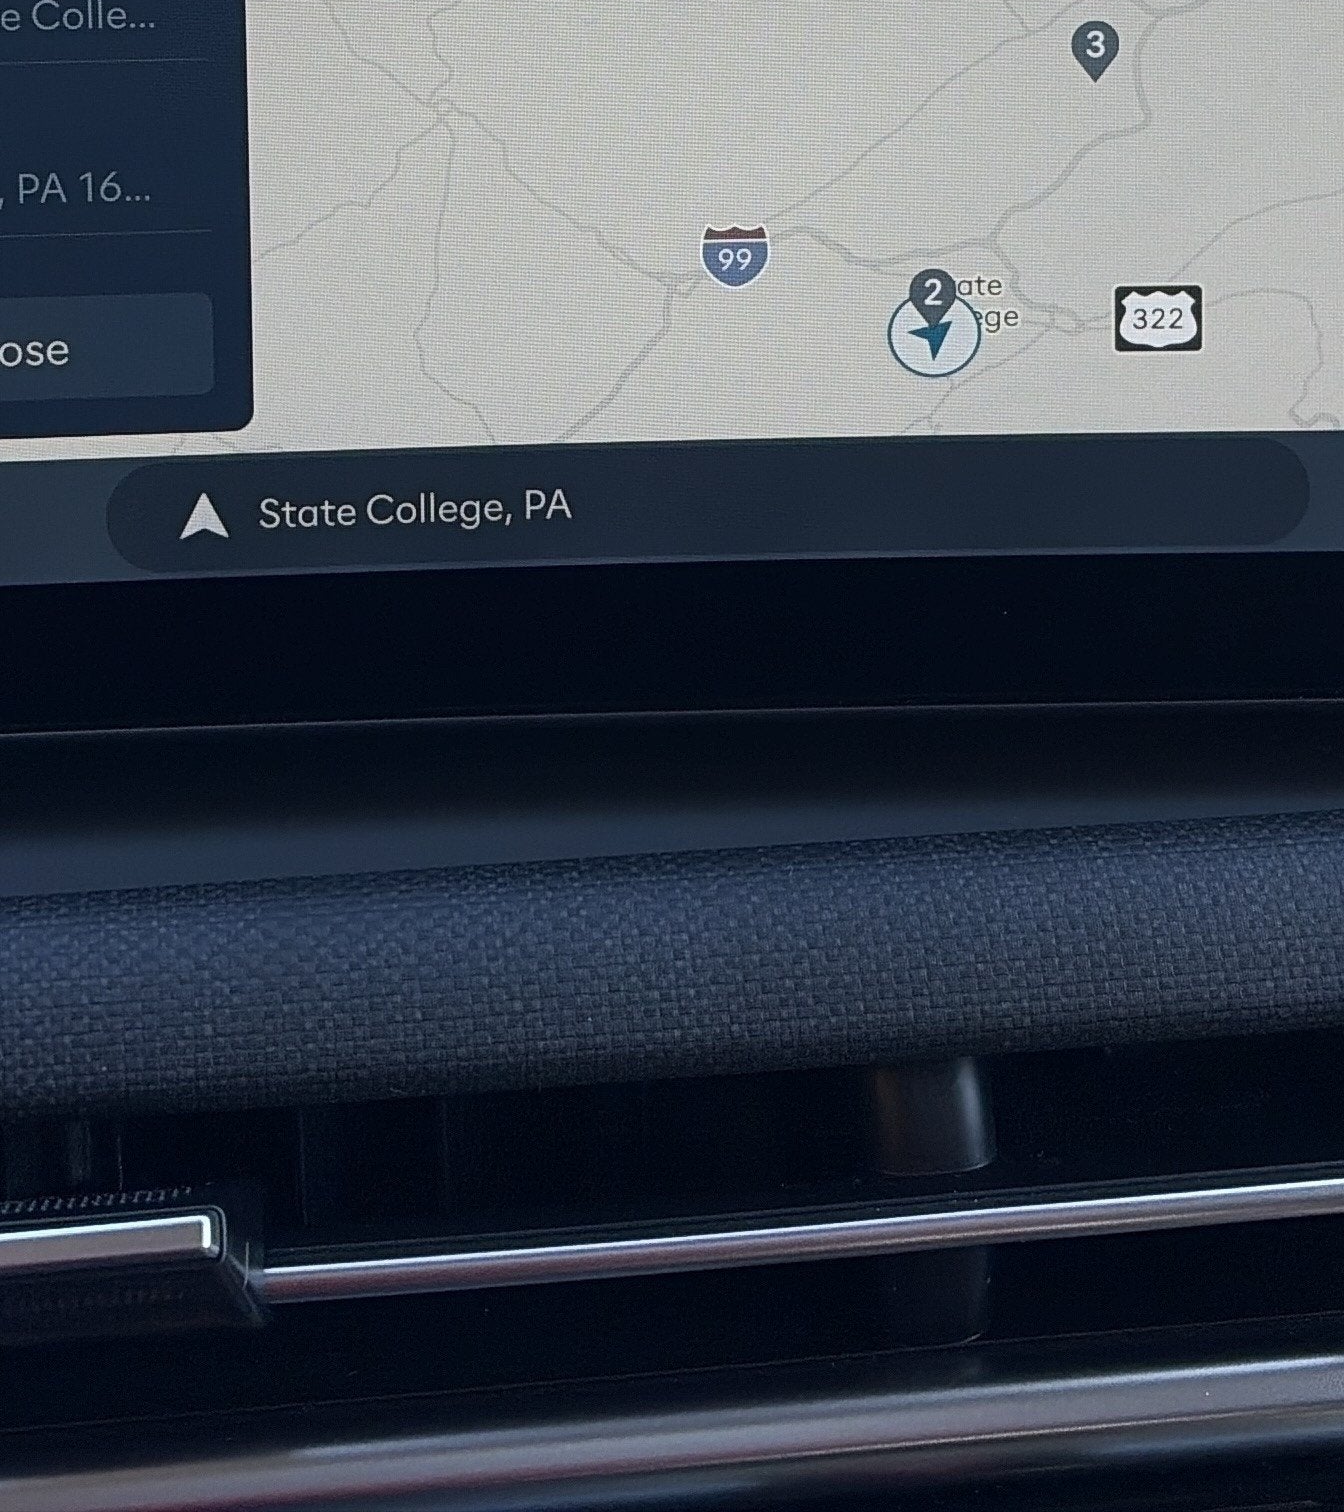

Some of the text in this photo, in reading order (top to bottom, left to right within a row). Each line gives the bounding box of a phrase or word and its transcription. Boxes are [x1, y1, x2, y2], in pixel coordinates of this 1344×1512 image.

[32, 0, 155, 33] Colle...
[1086, 31, 1105, 58] 3
[16, 173, 67, 206] PA
[79, 172, 151, 204] 16...
[718, 249, 752, 270] 99
[924, 279, 943, 306] 2
[957, 276, 1002, 296] ate
[1132, 309, 1183, 330] 322
[259, 490, 572, 530] State College, PA
